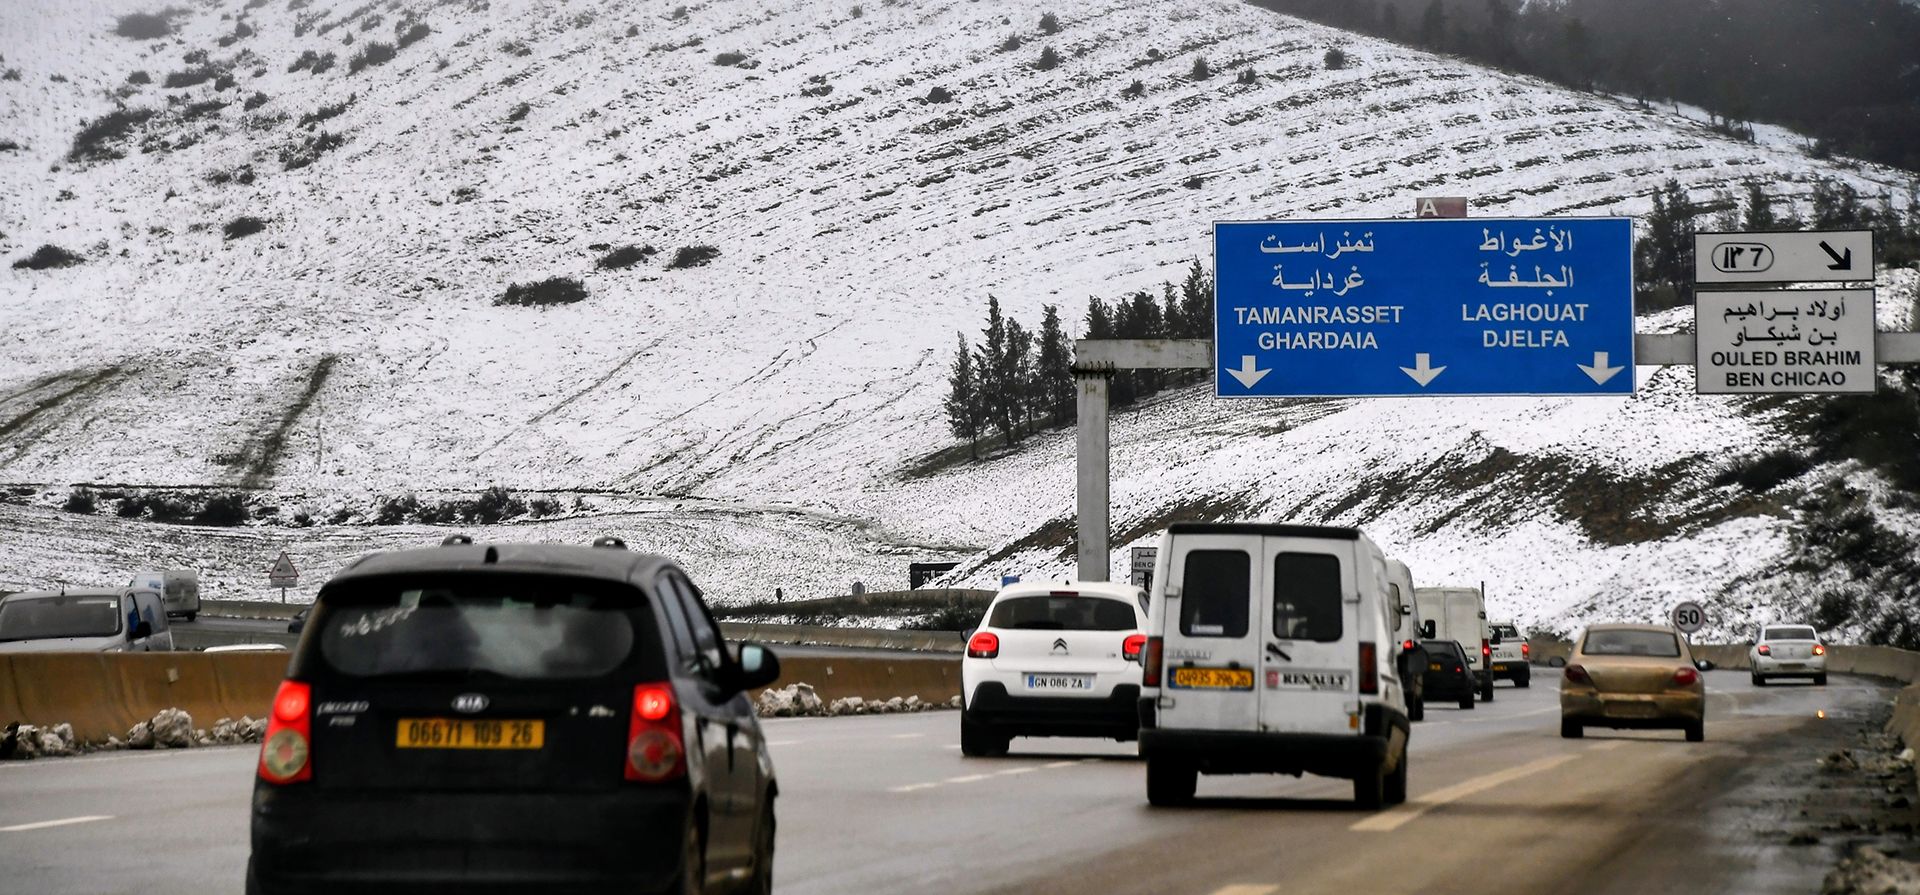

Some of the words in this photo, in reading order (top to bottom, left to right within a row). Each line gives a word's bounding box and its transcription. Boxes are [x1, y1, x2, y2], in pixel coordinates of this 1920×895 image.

[1419, 198, 1439, 217] A
[1260, 231, 1374, 260] تمنراست
[1479, 224, 1573, 258] الأغواط
[1271, 263, 1365, 297] غرداية
[1478, 261, 1574, 297] الجلفة
[1233, 305, 1404, 325] TAMANRASSET
[1461, 303, 1589, 322] LAGHOUAT
[1723, 300, 1799, 324] براهيم
[1806, 296, 1846, 321] أولاد
[1257, 331, 1379, 350] GHARDAIA
[1482, 329, 1570, 348] DJELFA
[1730, 323, 1801, 347] شيكاو
[1808, 327, 1838, 346] بن
[1710, 351, 1778, 367] OULED
[1783, 350, 1861, 366] BRAHIM
[1725, 371, 1765, 387] BEN
[1770, 370, 1846, 386] CHICAO
[1677, 609, 1700, 626] 50
[1282, 672, 1345, 687] RENAULT
